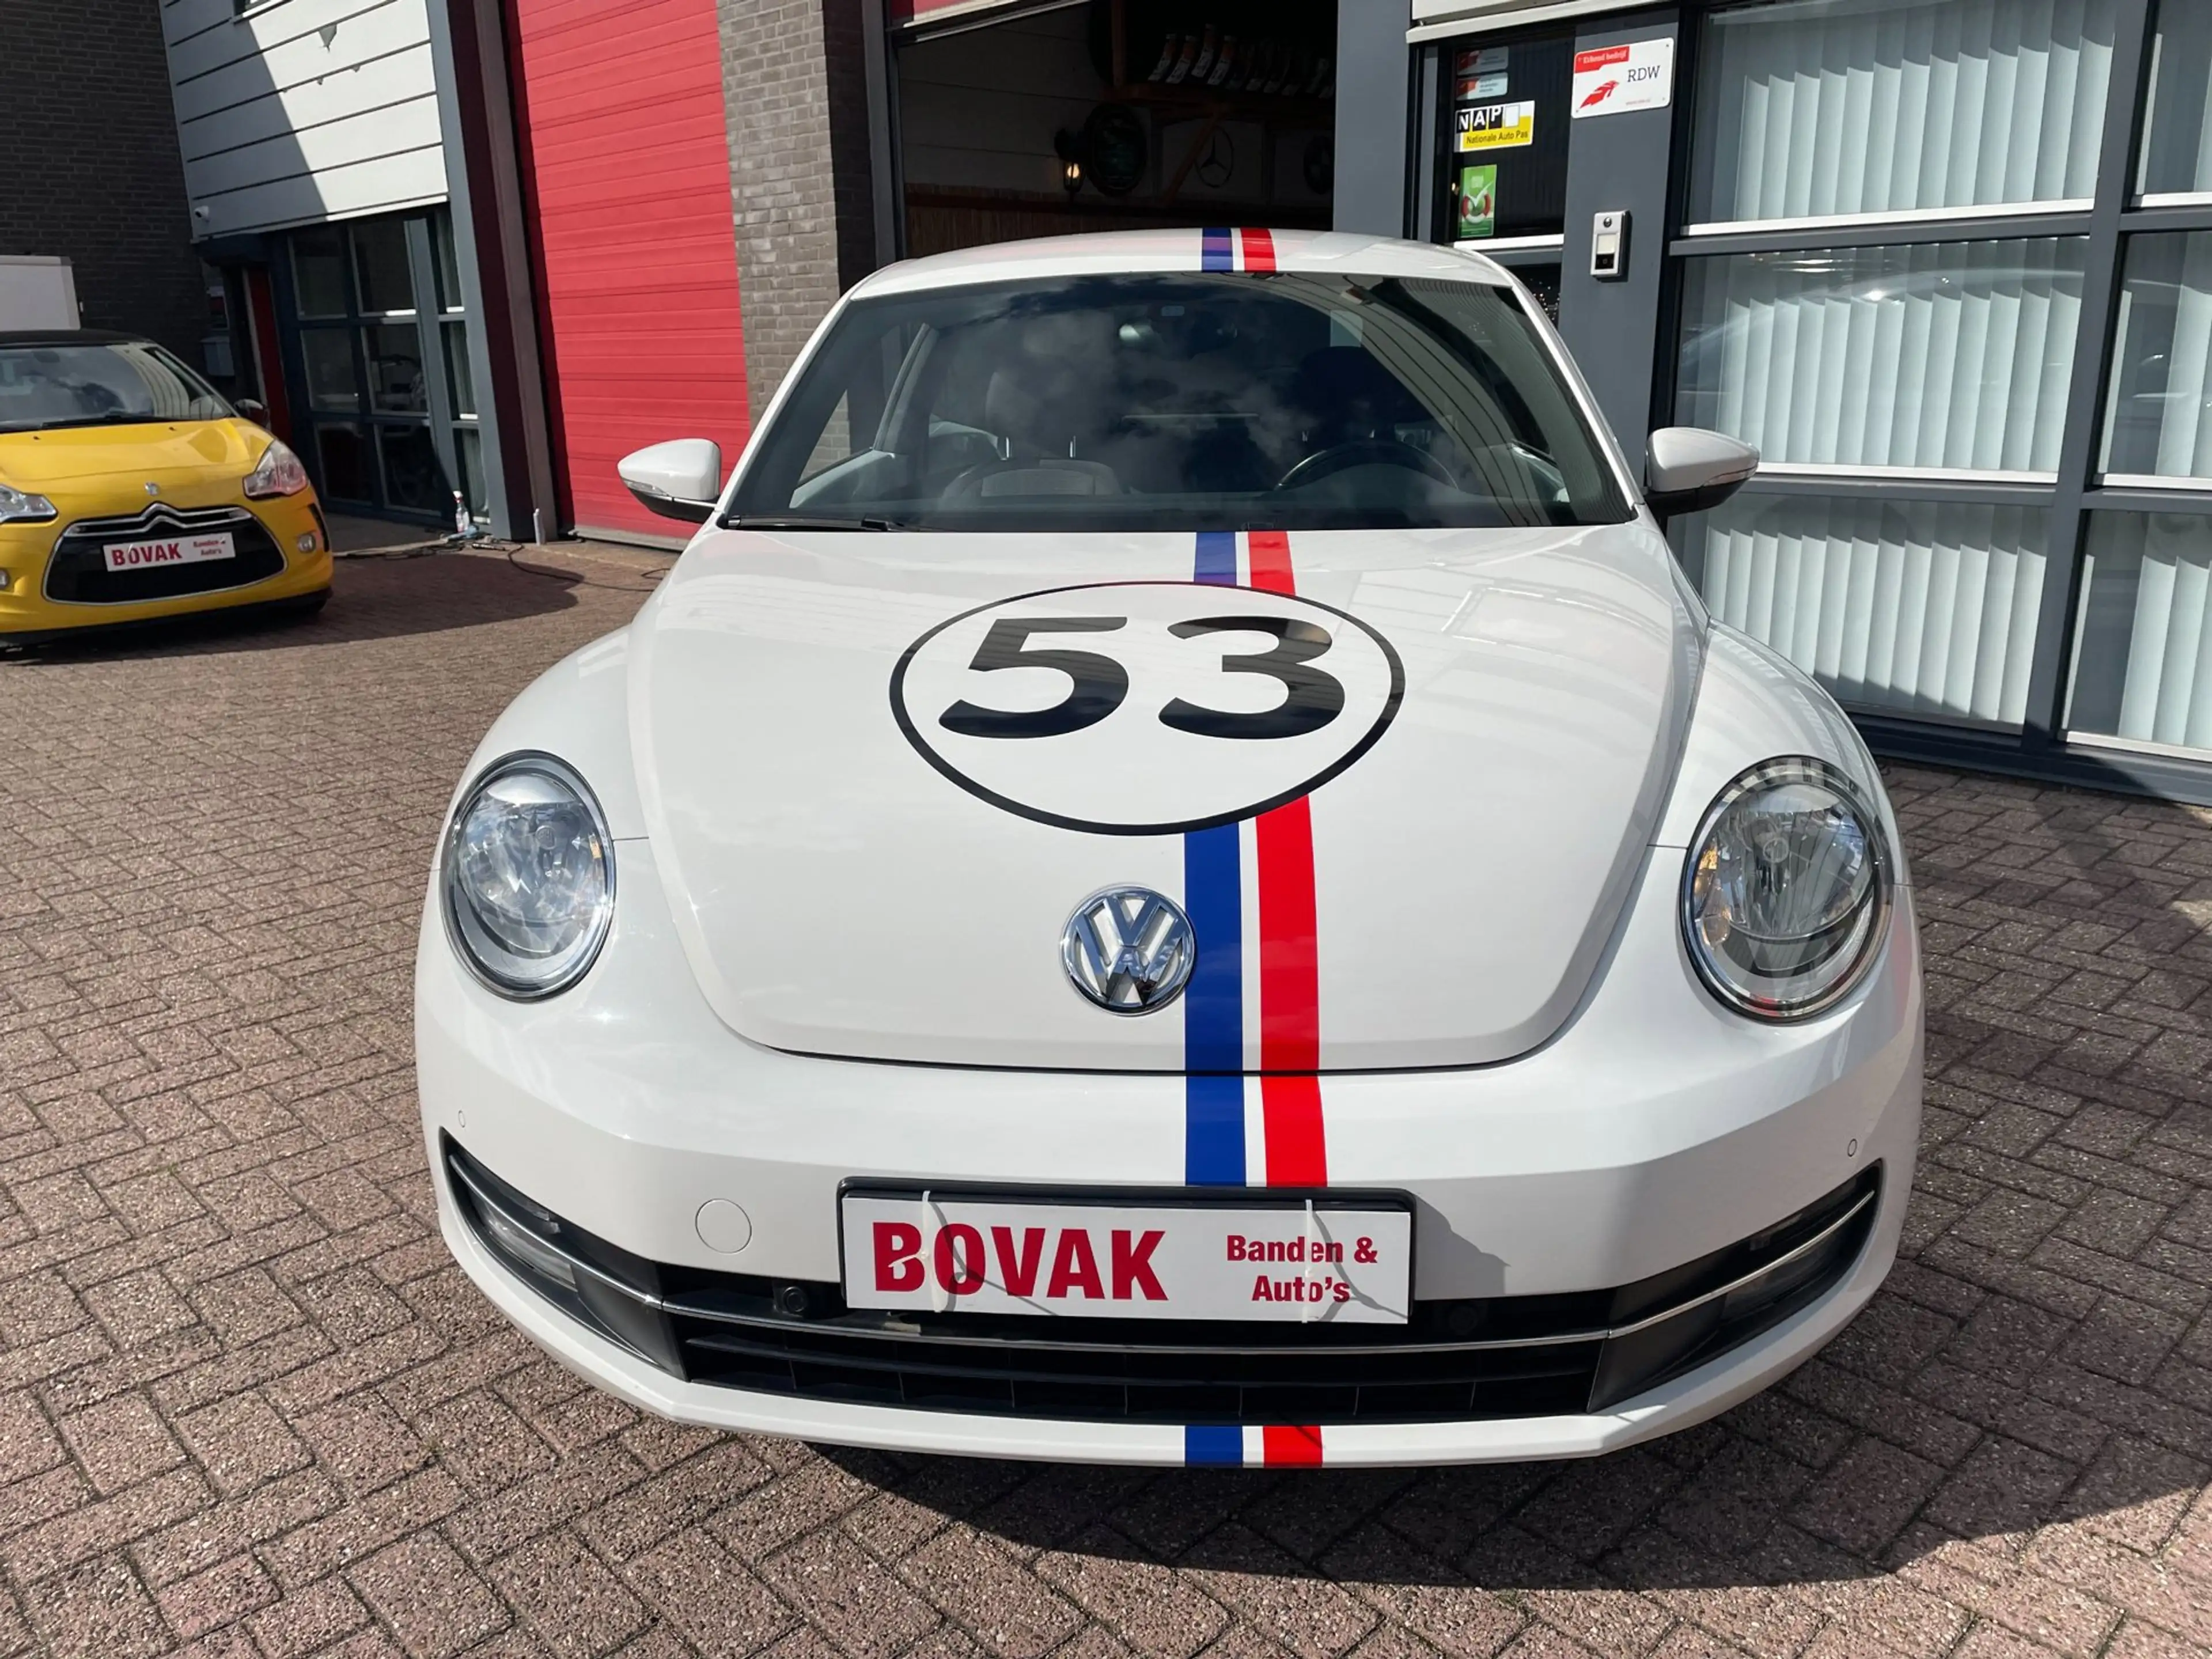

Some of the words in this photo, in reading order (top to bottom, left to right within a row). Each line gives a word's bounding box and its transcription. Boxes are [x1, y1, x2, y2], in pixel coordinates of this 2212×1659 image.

[1627, 65, 1661, 82] RDW
[1458, 107, 1502, 131] NAP
[1466, 133, 1497, 143] Nationale
[1498, 132, 1514, 141] Auto
[1515, 130, 1528, 138] Pas
[112, 543, 182, 566] BOVAK
[939, 616, 1346, 740] 53
[1227, 1234, 1343, 1263] Banden
[1354, 1236, 1378, 1263] &
[873, 1222, 1168, 1301] BOVAK
[1252, 1275, 1350, 1302] Auto's
